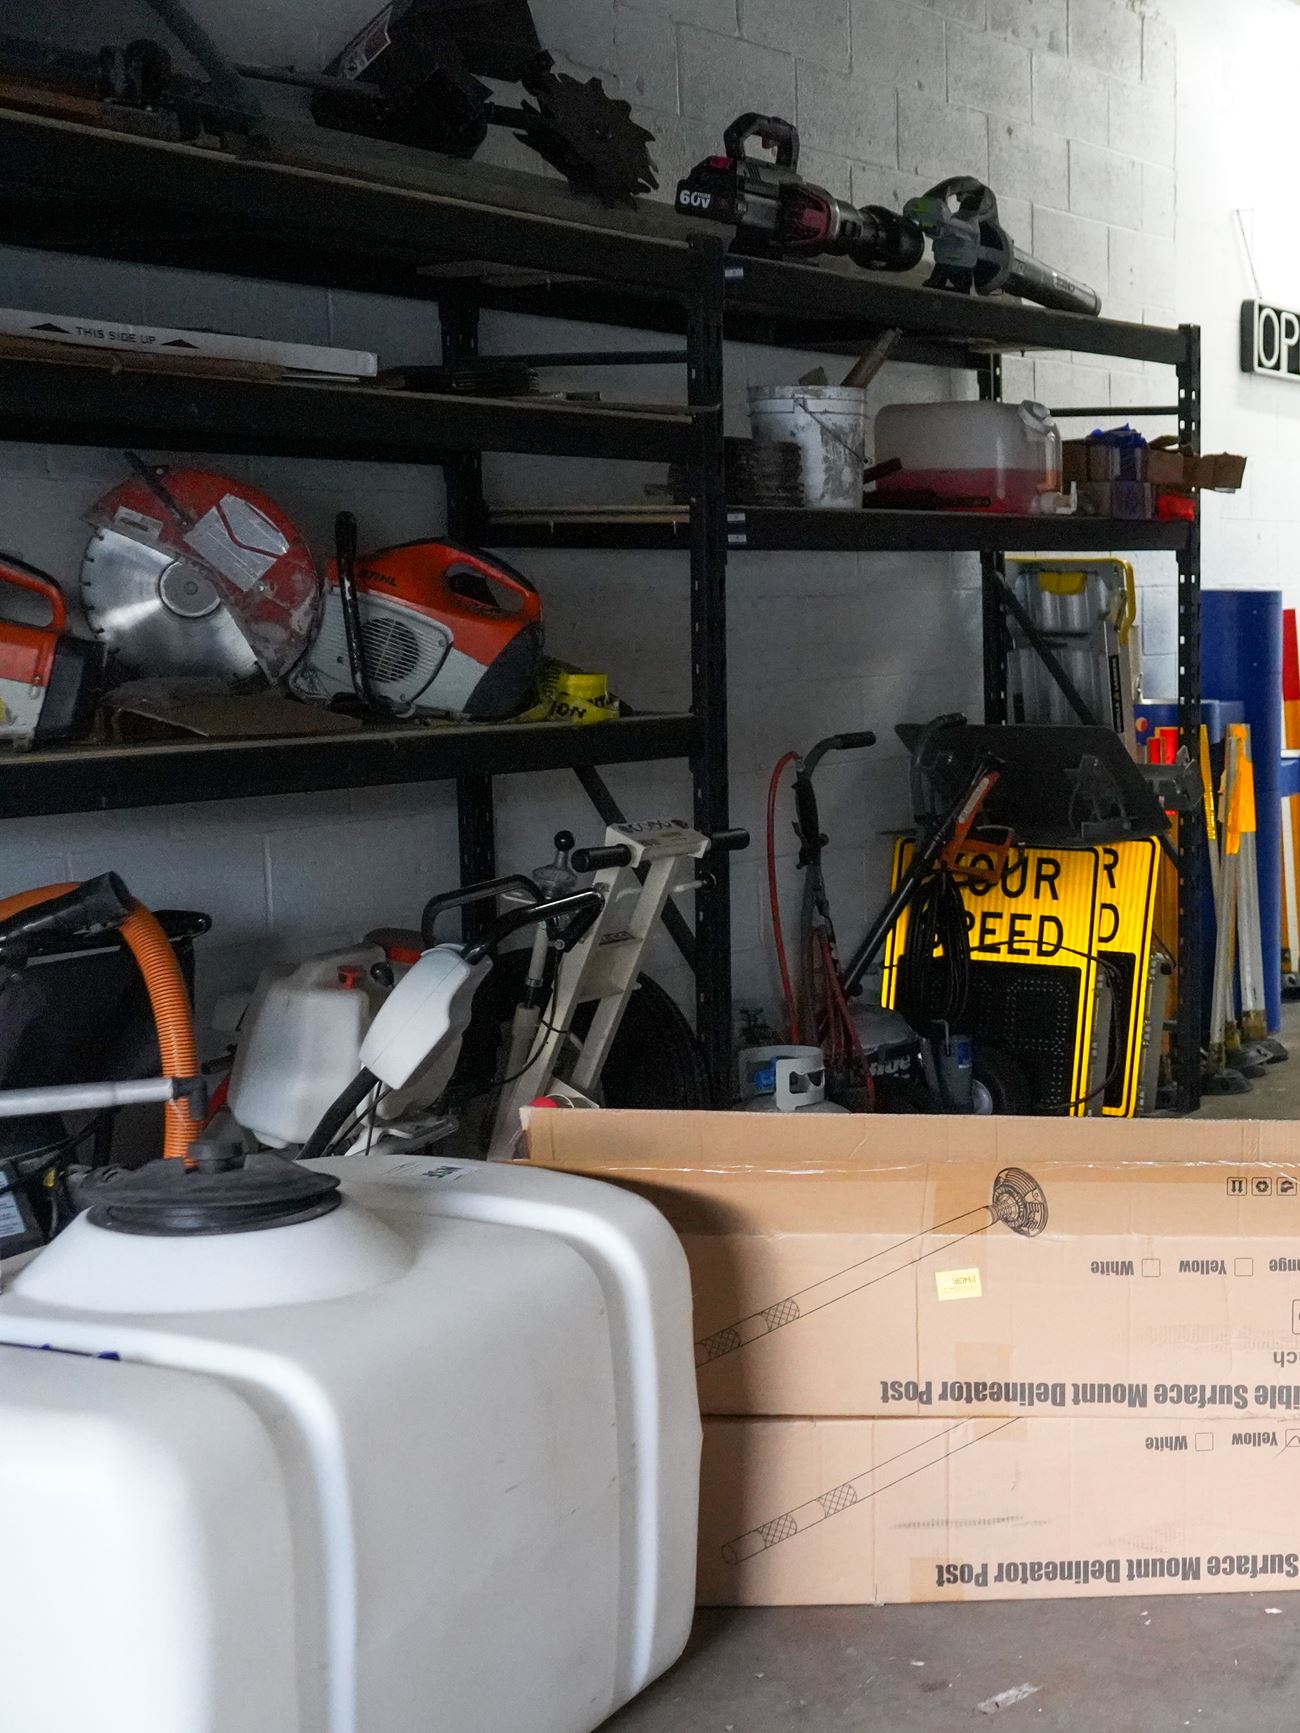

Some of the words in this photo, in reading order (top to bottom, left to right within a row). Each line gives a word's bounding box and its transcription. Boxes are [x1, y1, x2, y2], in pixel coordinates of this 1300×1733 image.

[679, 189, 711, 209] 60V
[76, 326, 105, 339] THIS
[109, 331, 137, 343] SIDE
[141, 335, 156, 345] UP
[359, 570, 397, 587] STIHL
[955, 851, 1062, 900] OUR
[934, 909, 1064, 958] EED
[1090, 1260, 1134, 1277] White
[1179, 1259, 1227, 1276] Yellow
[880, 1380, 933, 1406] Post
[938, 1380, 1066, 1407] Delineator
[1071, 1382, 1148, 1408] Mount
[1153, 1382, 1249, 1410] Surface
[1145, 1435, 1189, 1452] White
[1231, 1431, 1279, 1447] Yellow
[935, 1562, 989, 1588] Post
[994, 1559, 1121, 1585] Delineator
[1126, 1556, 1201, 1582] Mount
[1206, 1552, 1300, 1579] Surface
